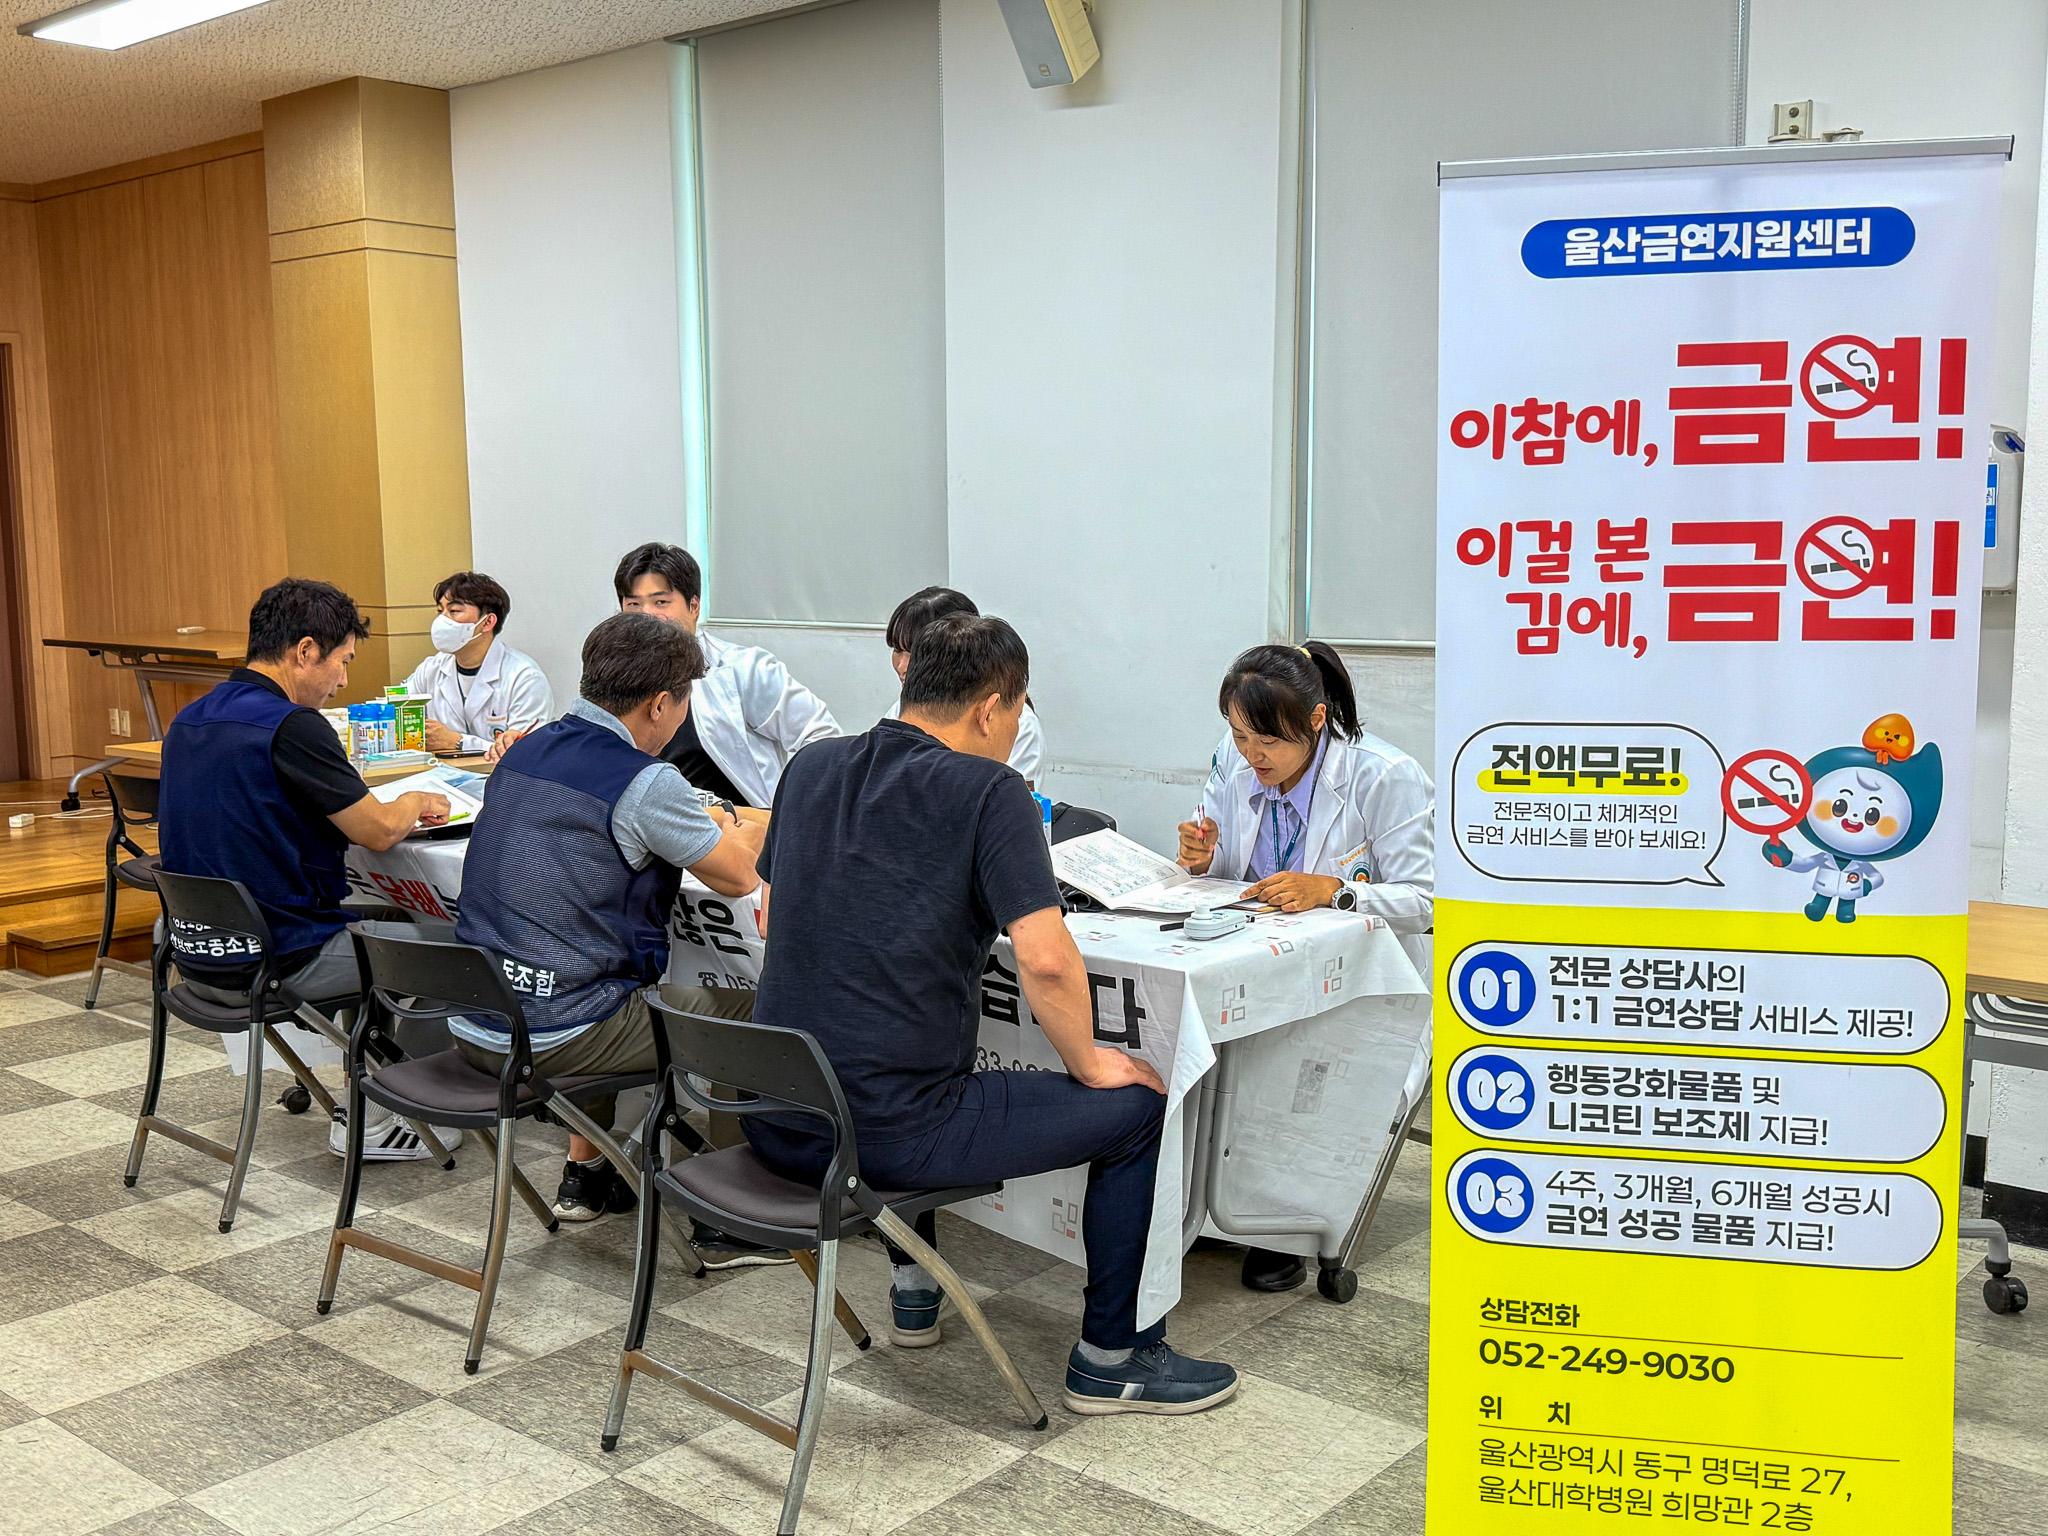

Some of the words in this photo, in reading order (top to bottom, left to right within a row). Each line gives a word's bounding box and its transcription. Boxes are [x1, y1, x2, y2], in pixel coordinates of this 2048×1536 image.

[1564, 216, 1871, 267] 울산금연지원센터
[1449, 397, 1659, 467] 이참에,
[1668, 334, 1968, 466] 금연!
[1455, 520, 1573, 584] 이걸
[1595, 517, 1650, 583] 본
[1662, 516, 1960, 643] 금연!
[1505, 592, 1648, 659] 김에,
[1491, 744, 1681, 789] 전액무료!
[1494, 801, 1592, 823] 전문적이고
[1597, 802, 1678, 826] 체계적인
[1467, 824, 1505, 847] 금연
[1510, 825, 1588, 848] 서비스를
[1594, 827, 1635, 850] 받아
[1638, 828, 1706, 851] 보세요!
[1469, 967, 1522, 1012] 01
[1549, 955, 1611, 988] 전문
[1619, 957, 1745, 994] 상담사의
[1552, 994, 1598, 1025] 1:1
[1613, 996, 1742, 1032] 금연상담
[1750, 1006, 1838, 1036] 서비스
[1847, 1009, 1914, 1039] 제공!
[1466, 1068, 1526, 1114] 02
[1548, 1062, 1742, 1103] 행동강화물품
[1752, 1076, 1781, 1106] 및
[1548, 1100, 1641, 1137] 니코틴
[1652, 1106, 1750, 1142] 보조제
[1759, 1115, 1828, 1147] 지급!
[1466, 1171, 1526, 1217] 03
[1545, 1170, 1604, 1203] 4주,
[1613, 1172, 1702, 1209] 3개월,
[1710, 1178, 1793, 1212] 6개월
[1801, 1183, 1891, 1217] 성공시
[1545, 1203, 1608, 1238] 금연
[1618, 1207, 1681, 1242] 성공
[1692, 1211, 1755, 1247] 물품
[1765, 1218, 1834, 1253] 지급!
[1480, 1296, 1580, 1329] 상담전화
[1479, 1337, 1735, 1384] 052-249-9030
[1479, 1394, 1503, 1421] 위
[1547, 1400, 1571, 1427] 치
[1478, 1437, 1623, 1478] 울산광역시
[1633, 1450, 1692, 1483] 동구
[1702, 1455, 1792, 1492] 명덕로
[1800, 1465, 1852, 1503] 27,
[1477, 1473, 1653, 1516] 울산대학병원
[1662, 1491, 1753, 1527] 희망관
[1761, 1502, 1814, 1532] 2층
